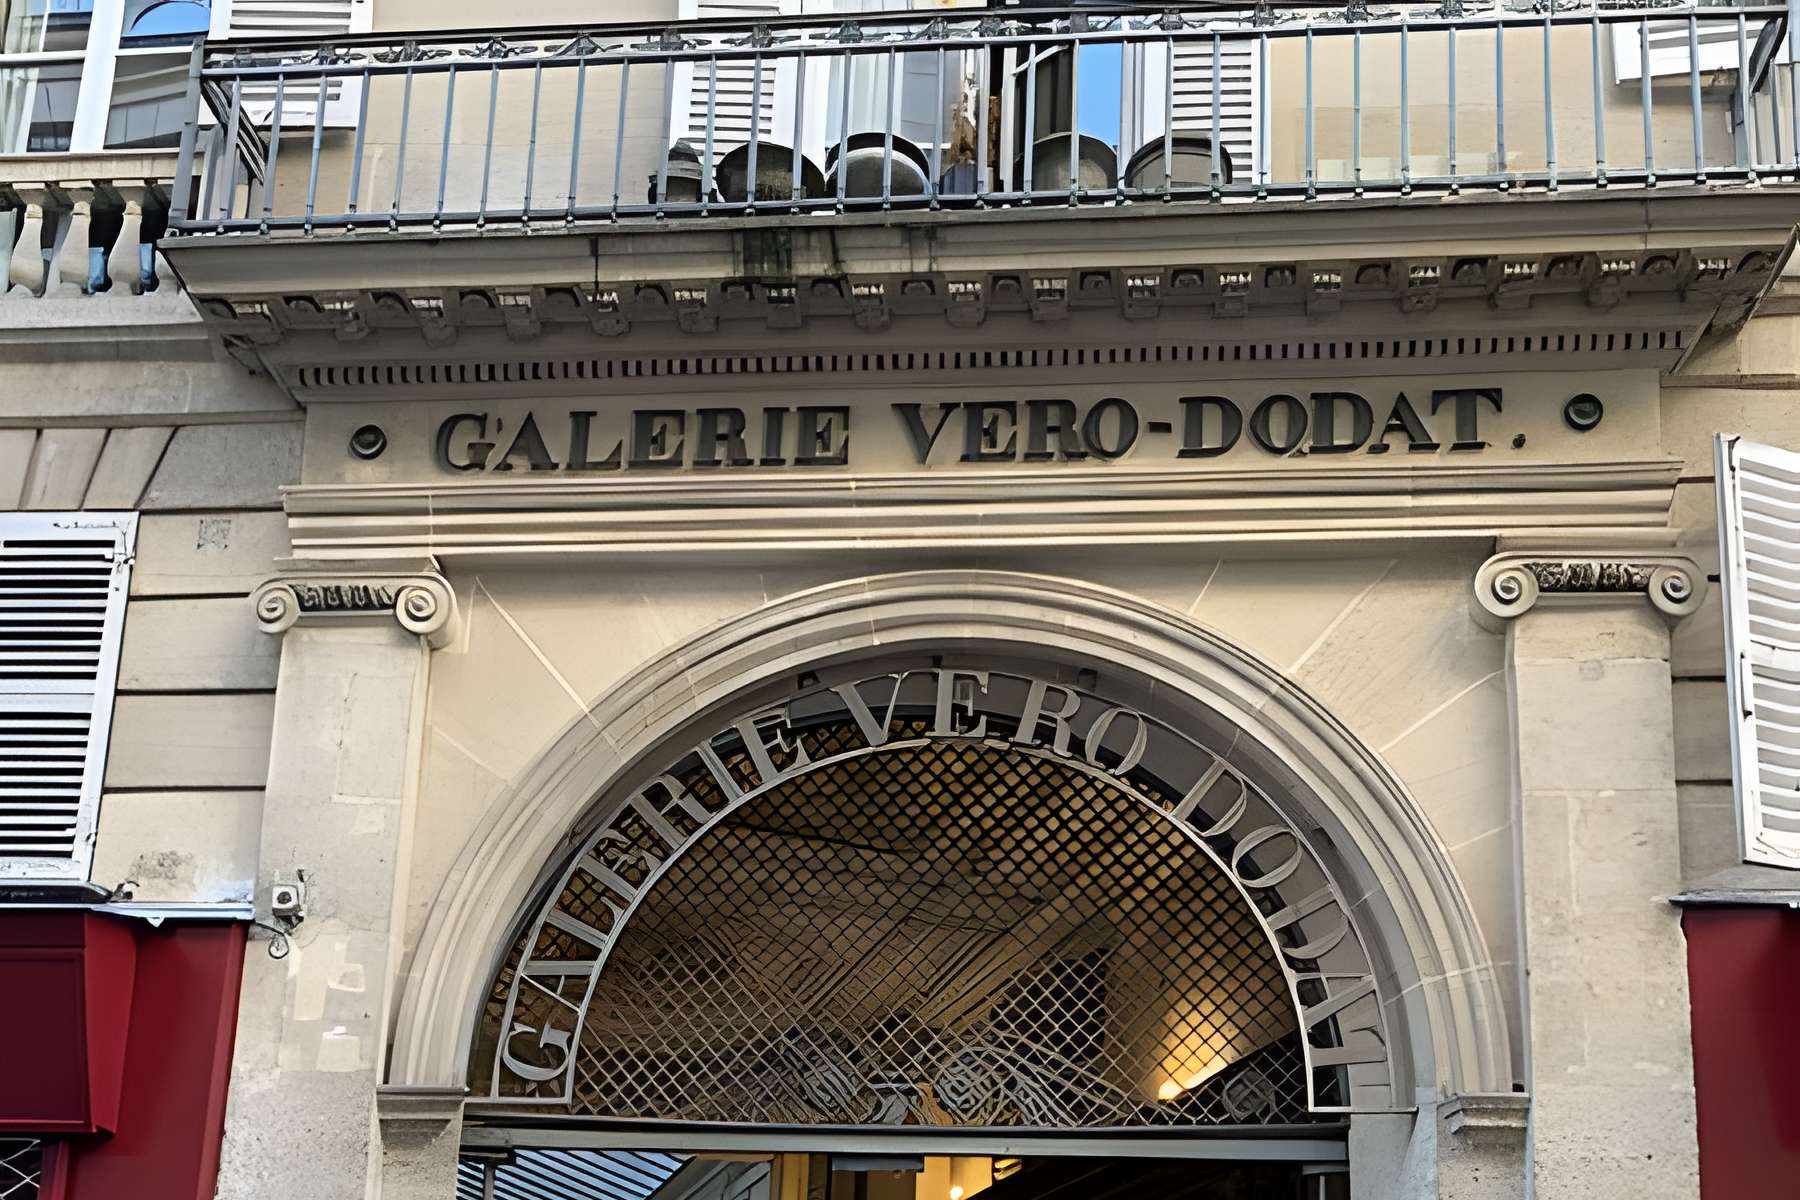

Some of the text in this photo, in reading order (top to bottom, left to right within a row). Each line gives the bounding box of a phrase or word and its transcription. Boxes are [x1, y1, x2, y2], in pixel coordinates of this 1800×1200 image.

[502, 668, 1390, 1087] GALERIE VERO DODAT
